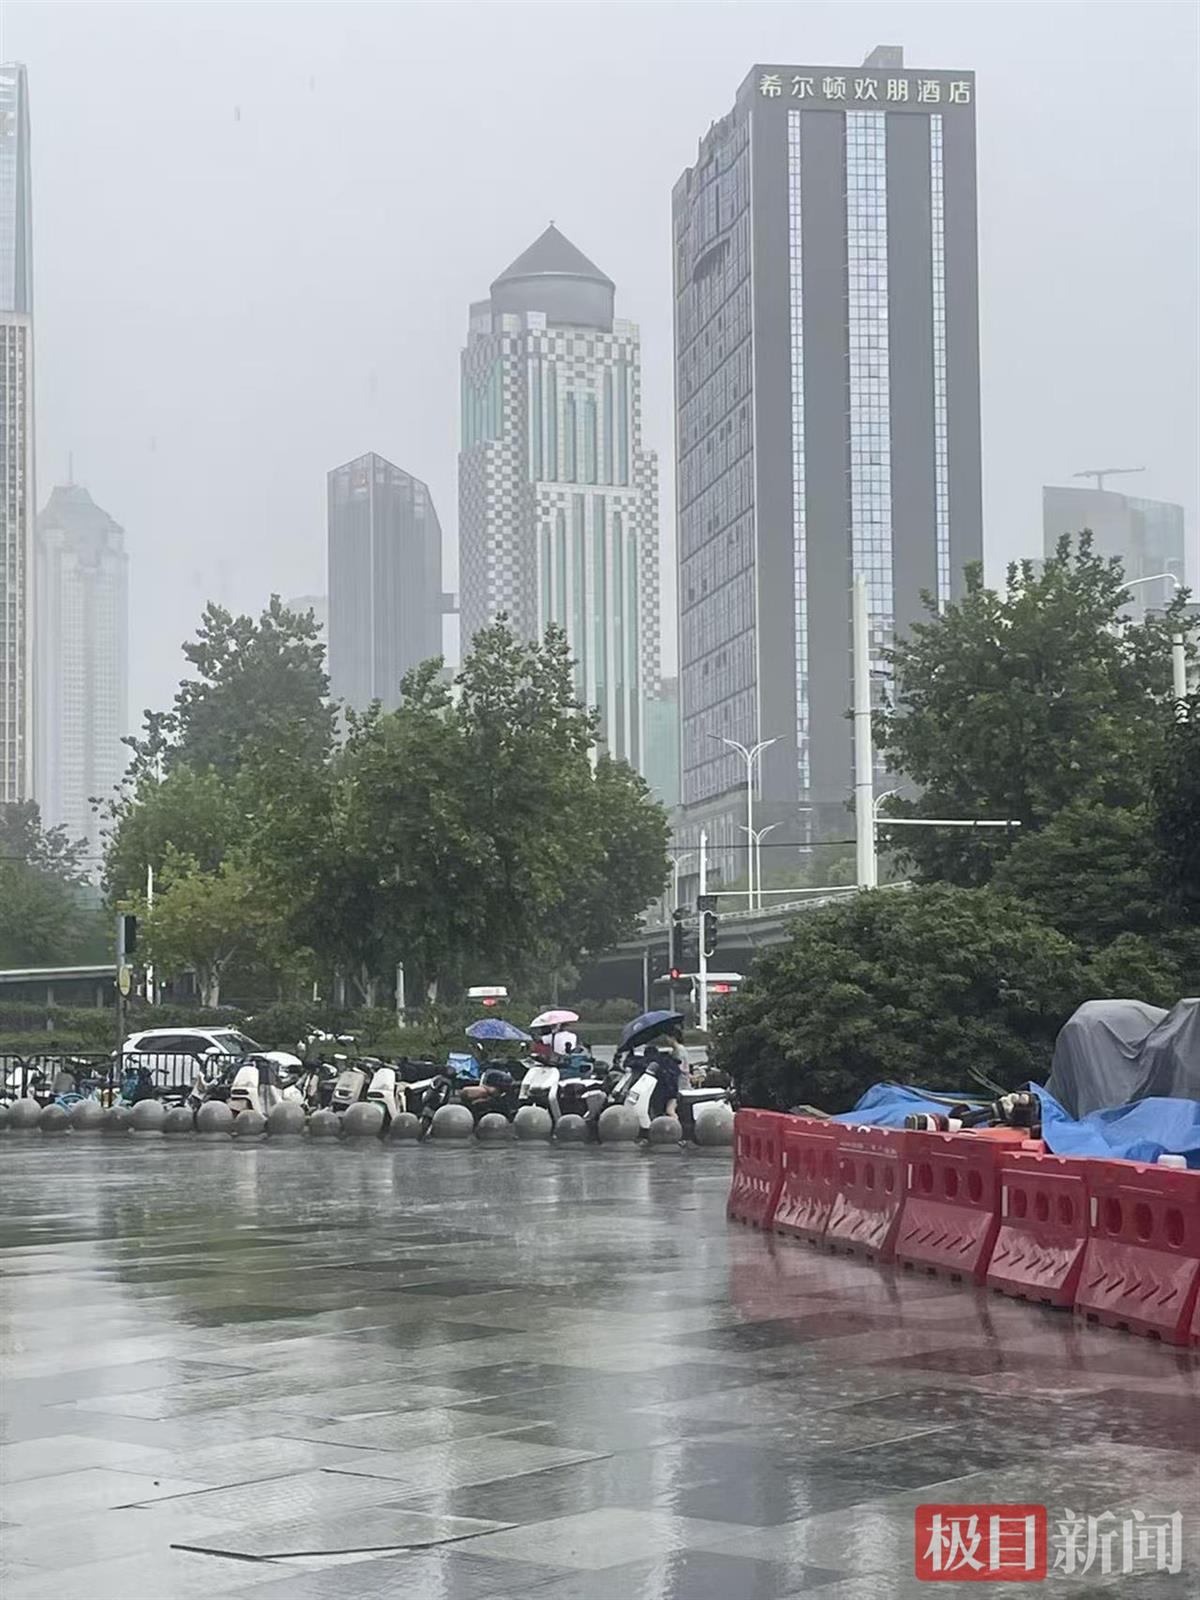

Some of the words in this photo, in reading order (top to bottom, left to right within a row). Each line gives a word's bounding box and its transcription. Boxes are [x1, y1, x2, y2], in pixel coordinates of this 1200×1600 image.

[759, 73, 971, 104] 希尔顿欢朋酒店
